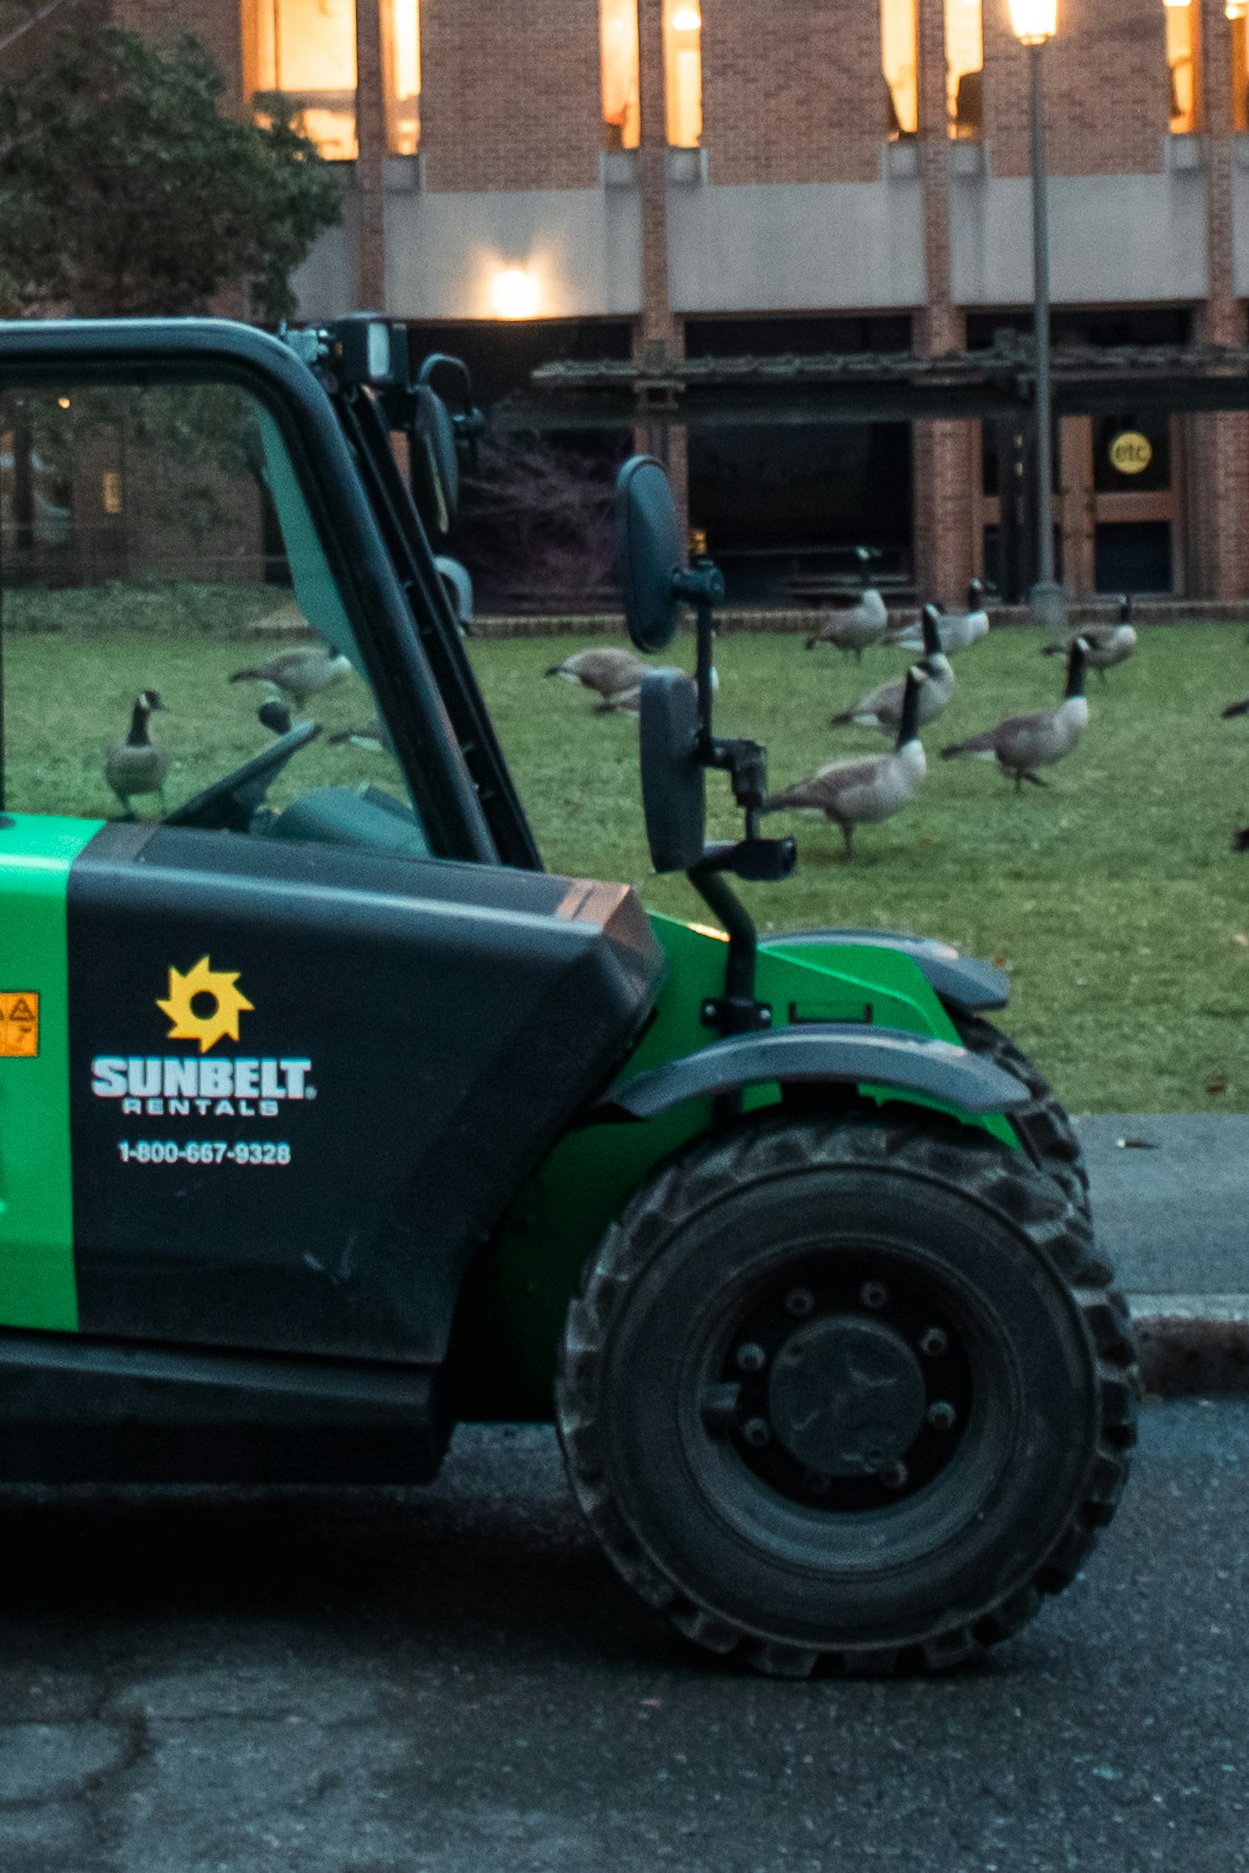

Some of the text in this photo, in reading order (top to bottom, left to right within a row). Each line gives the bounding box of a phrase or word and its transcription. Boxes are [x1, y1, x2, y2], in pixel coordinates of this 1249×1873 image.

[91, 1055, 313, 1099] SUNBELT
[122, 1098, 279, 1116] RENTALS
[118, 1140, 292, 1165] 1-800-667-9328
